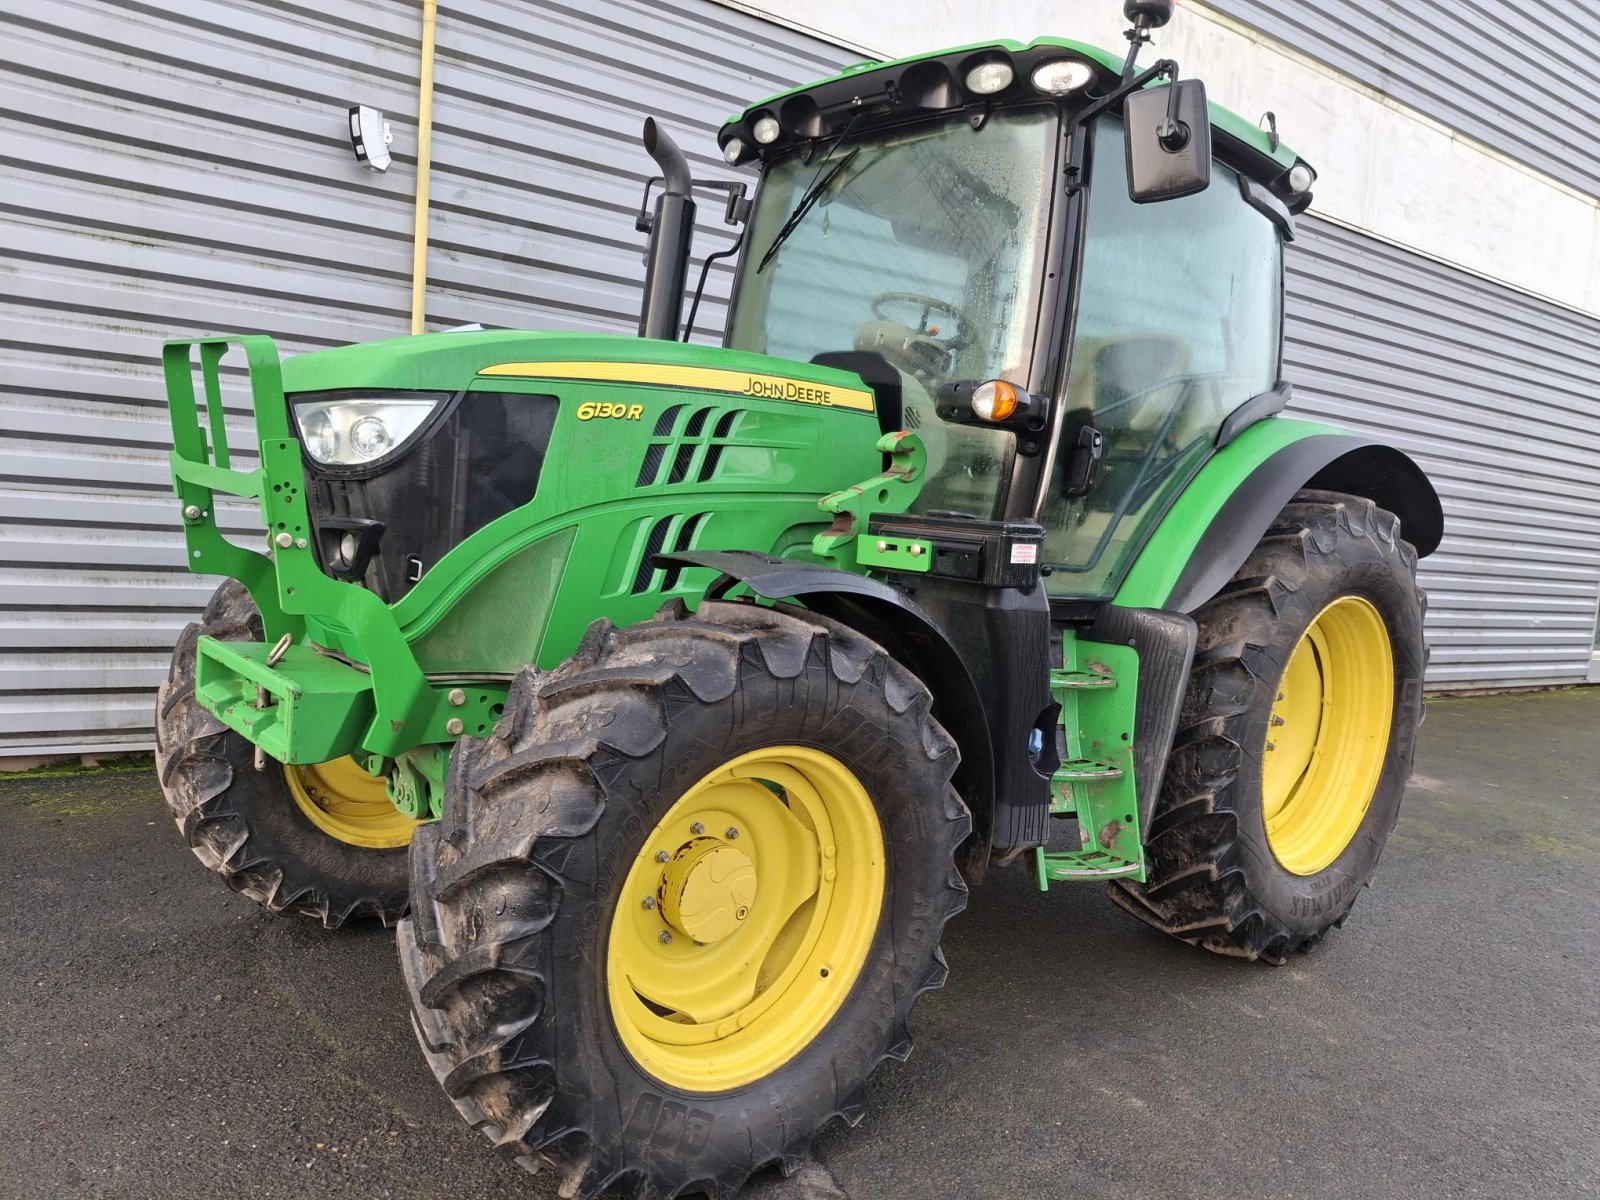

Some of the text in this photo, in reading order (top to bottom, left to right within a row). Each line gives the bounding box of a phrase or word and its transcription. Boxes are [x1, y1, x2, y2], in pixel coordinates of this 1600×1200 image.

[743, 377, 832, 404] JOHN DEERE
[623, 1093, 715, 1154] BKT
